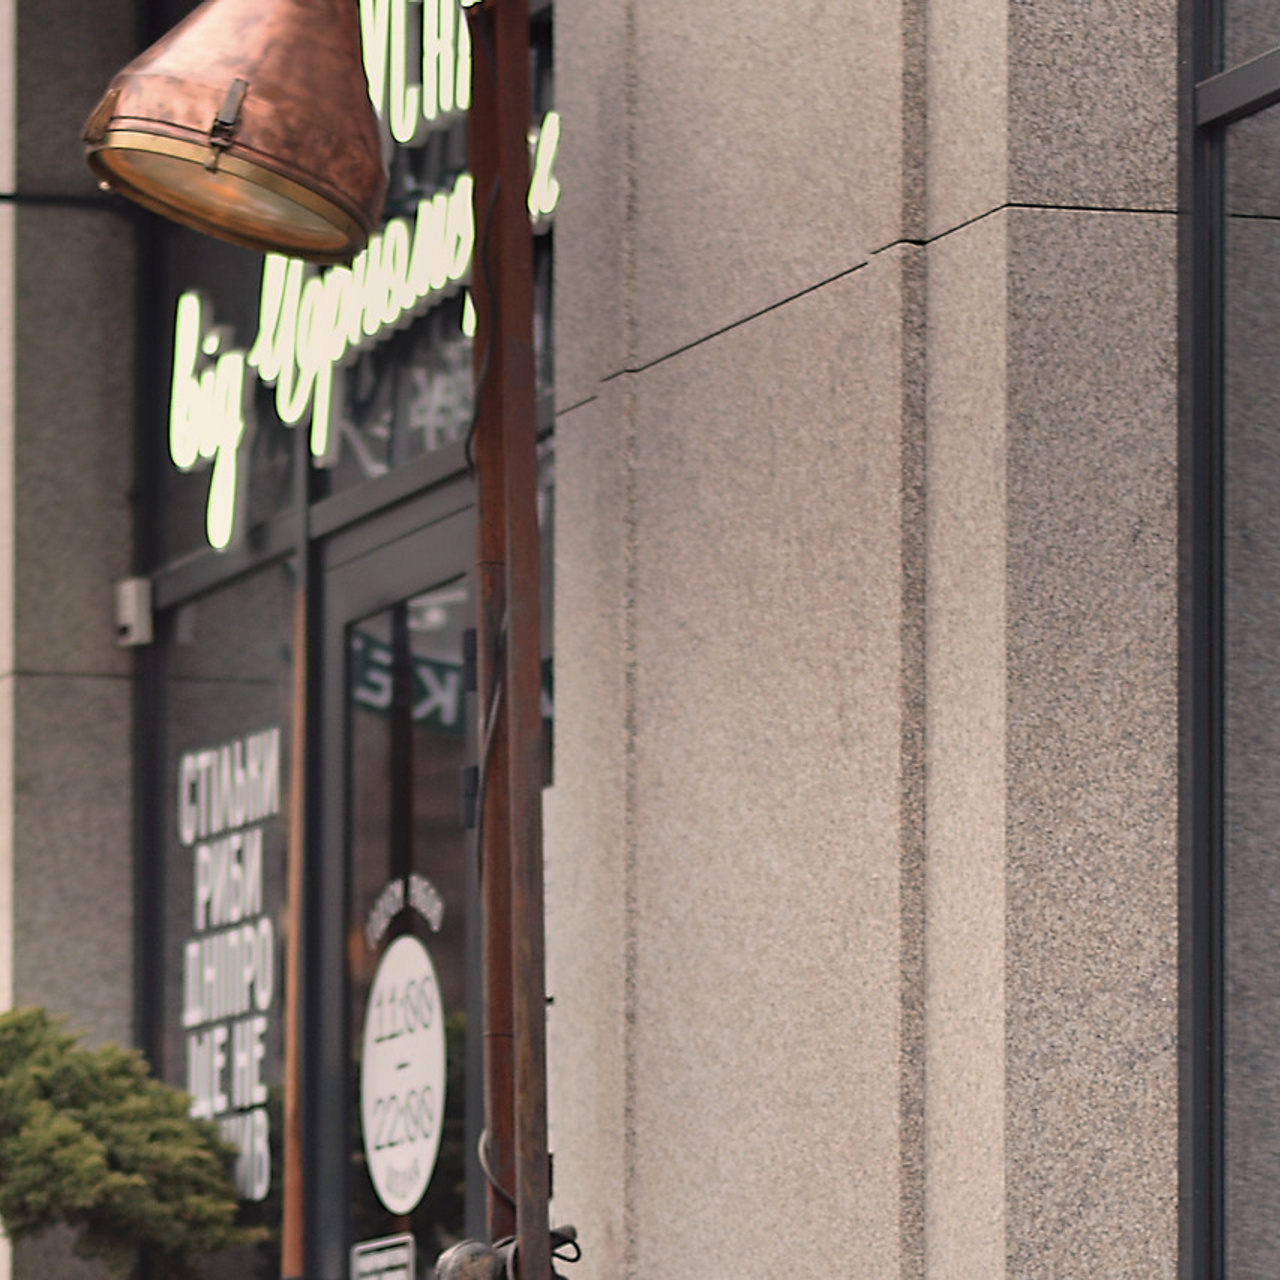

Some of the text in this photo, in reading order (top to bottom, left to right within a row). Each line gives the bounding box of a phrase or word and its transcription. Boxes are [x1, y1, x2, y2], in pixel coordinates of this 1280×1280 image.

[194, 829, 263, 931] РИБИ
[182, 917, 275, 1027] ДНІПРО
[232, 1015, 269, 1107] НЕ
